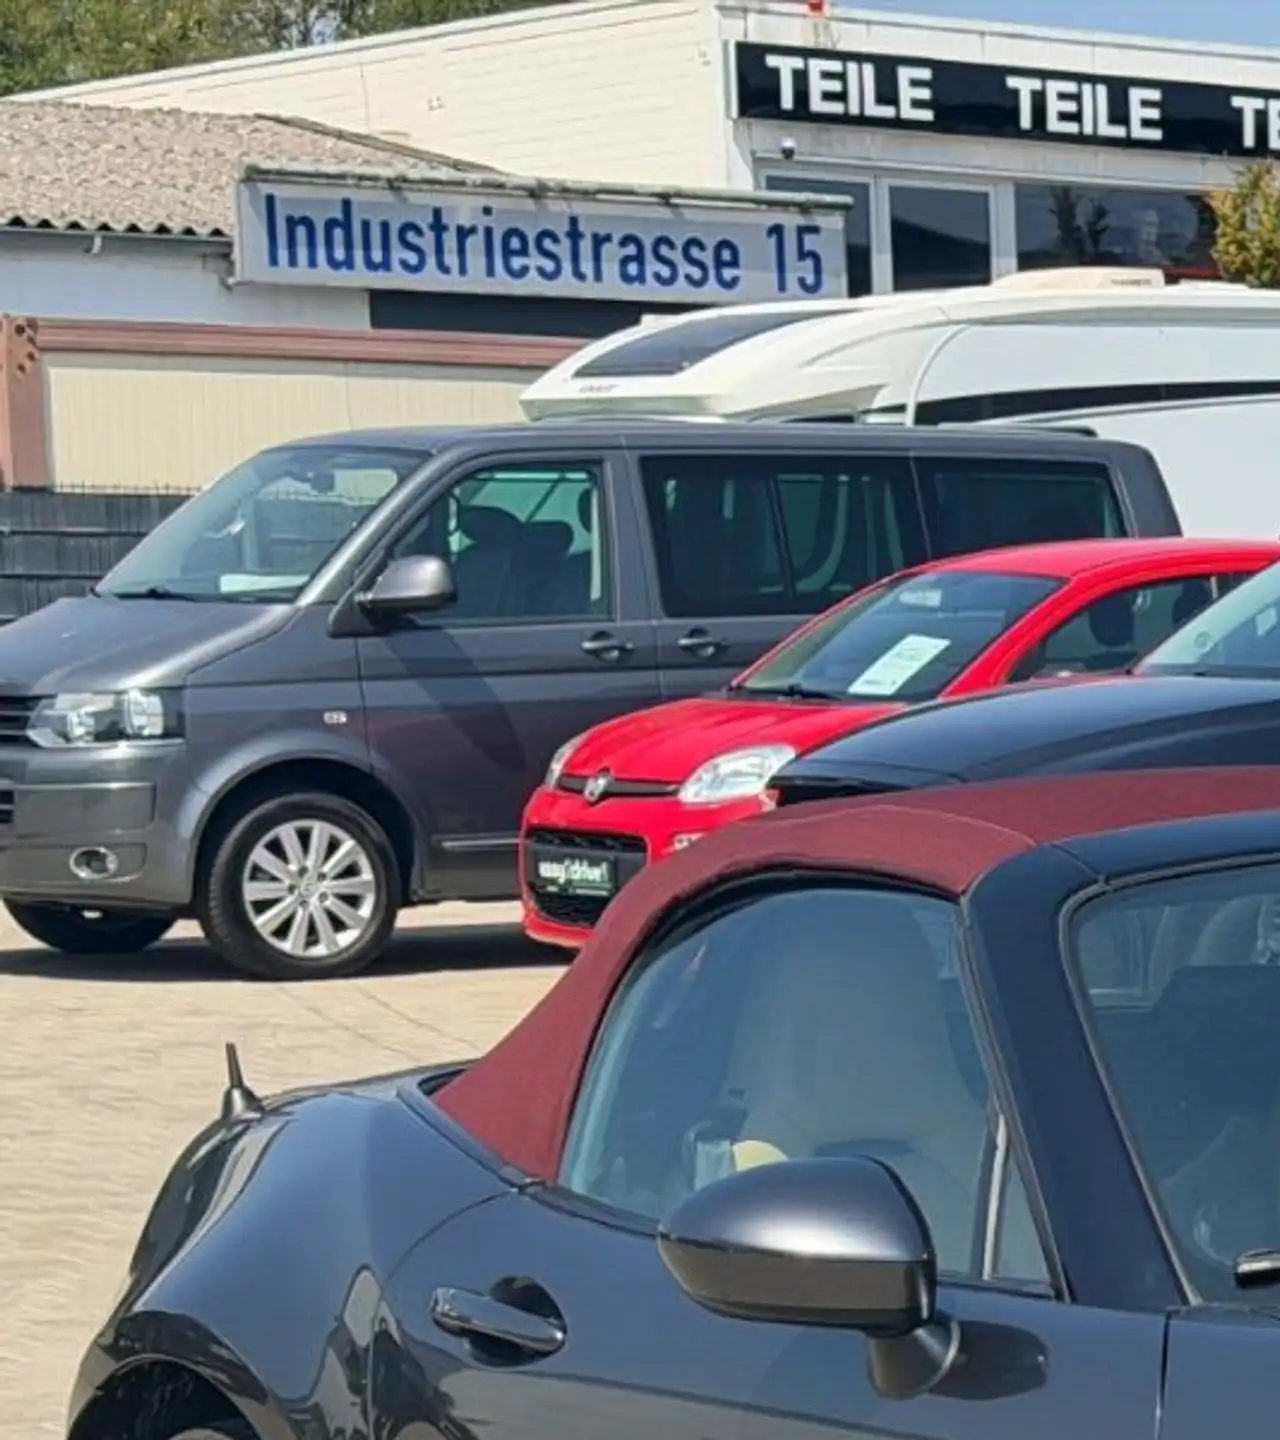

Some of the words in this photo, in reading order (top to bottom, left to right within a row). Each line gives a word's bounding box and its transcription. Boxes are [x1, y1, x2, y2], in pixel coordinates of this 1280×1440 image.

[764, 53, 935, 122] TEILE
[1006, 75, 1164, 142] TEILE
[263, 192, 741, 291] Industriestrasse
[765, 222, 824, 295] 15
